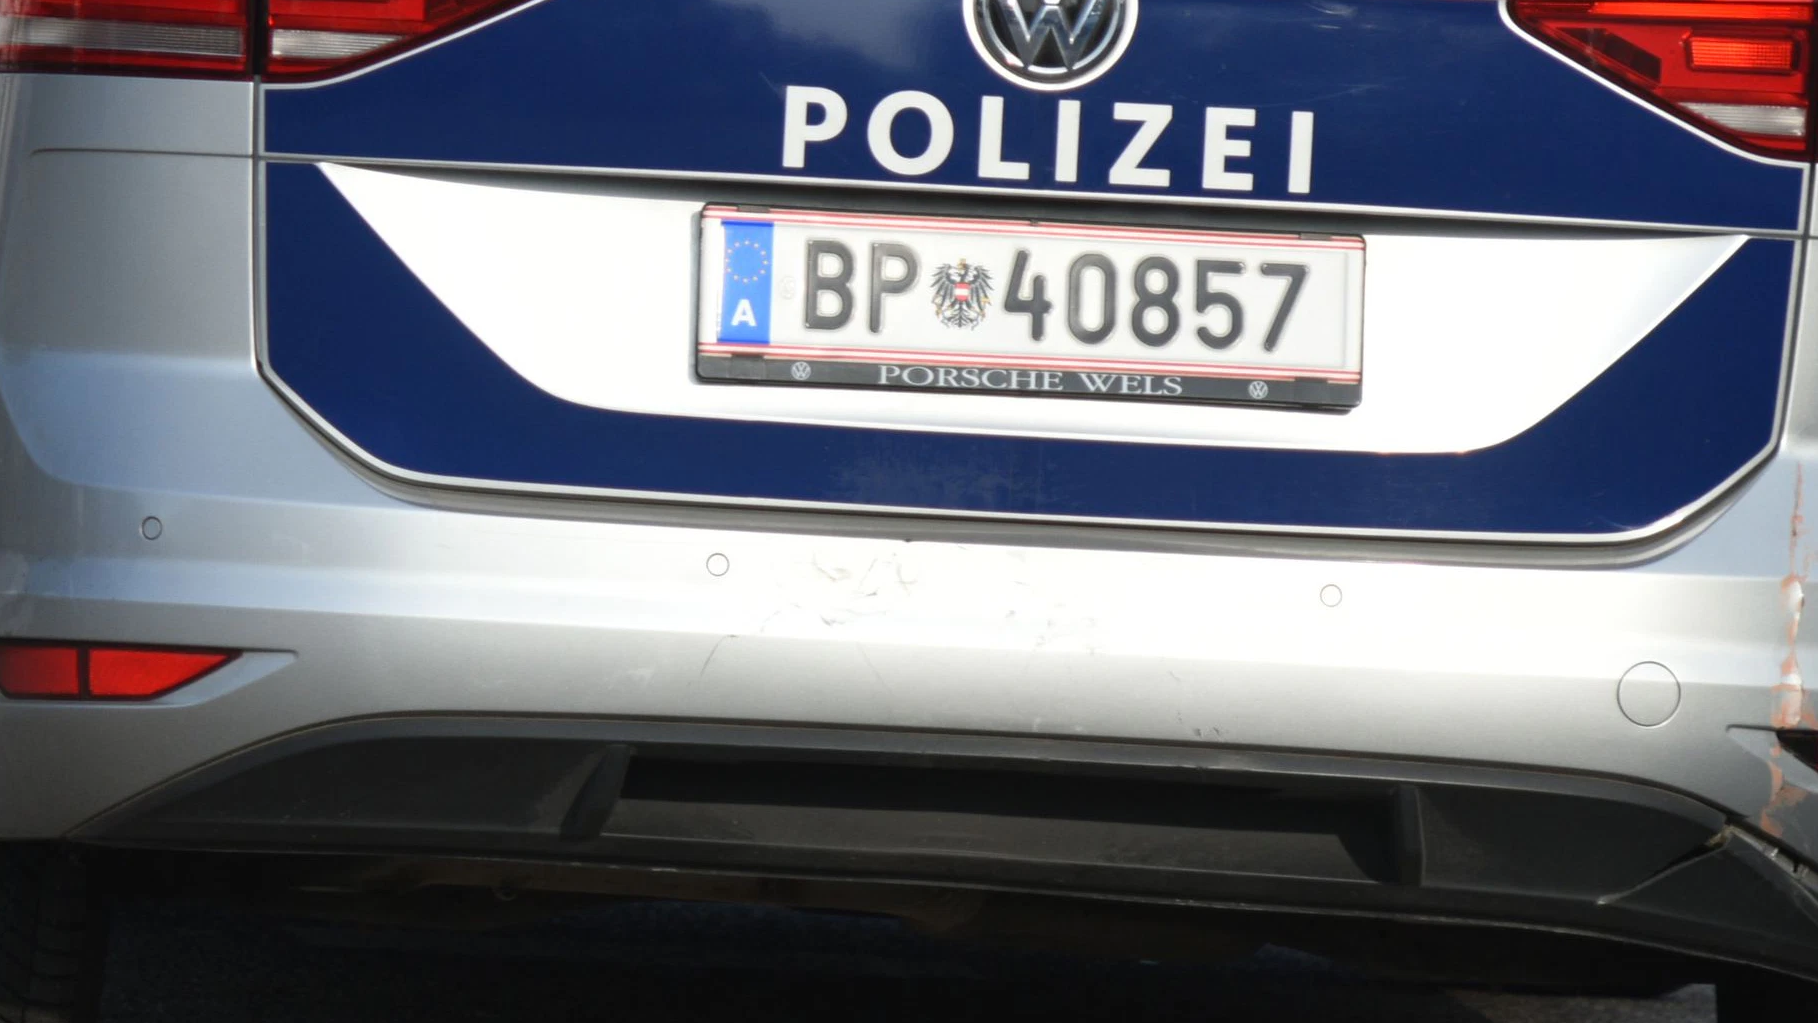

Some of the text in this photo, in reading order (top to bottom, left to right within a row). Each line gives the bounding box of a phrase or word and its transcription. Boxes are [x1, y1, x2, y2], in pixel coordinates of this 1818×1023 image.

[782, 85, 1314, 194] POLIZEI
[731, 299, 757, 327] A
[804, 239, 1310, 353] BP 40857
[878, 365, 1183, 395] PORSCHE WELS
